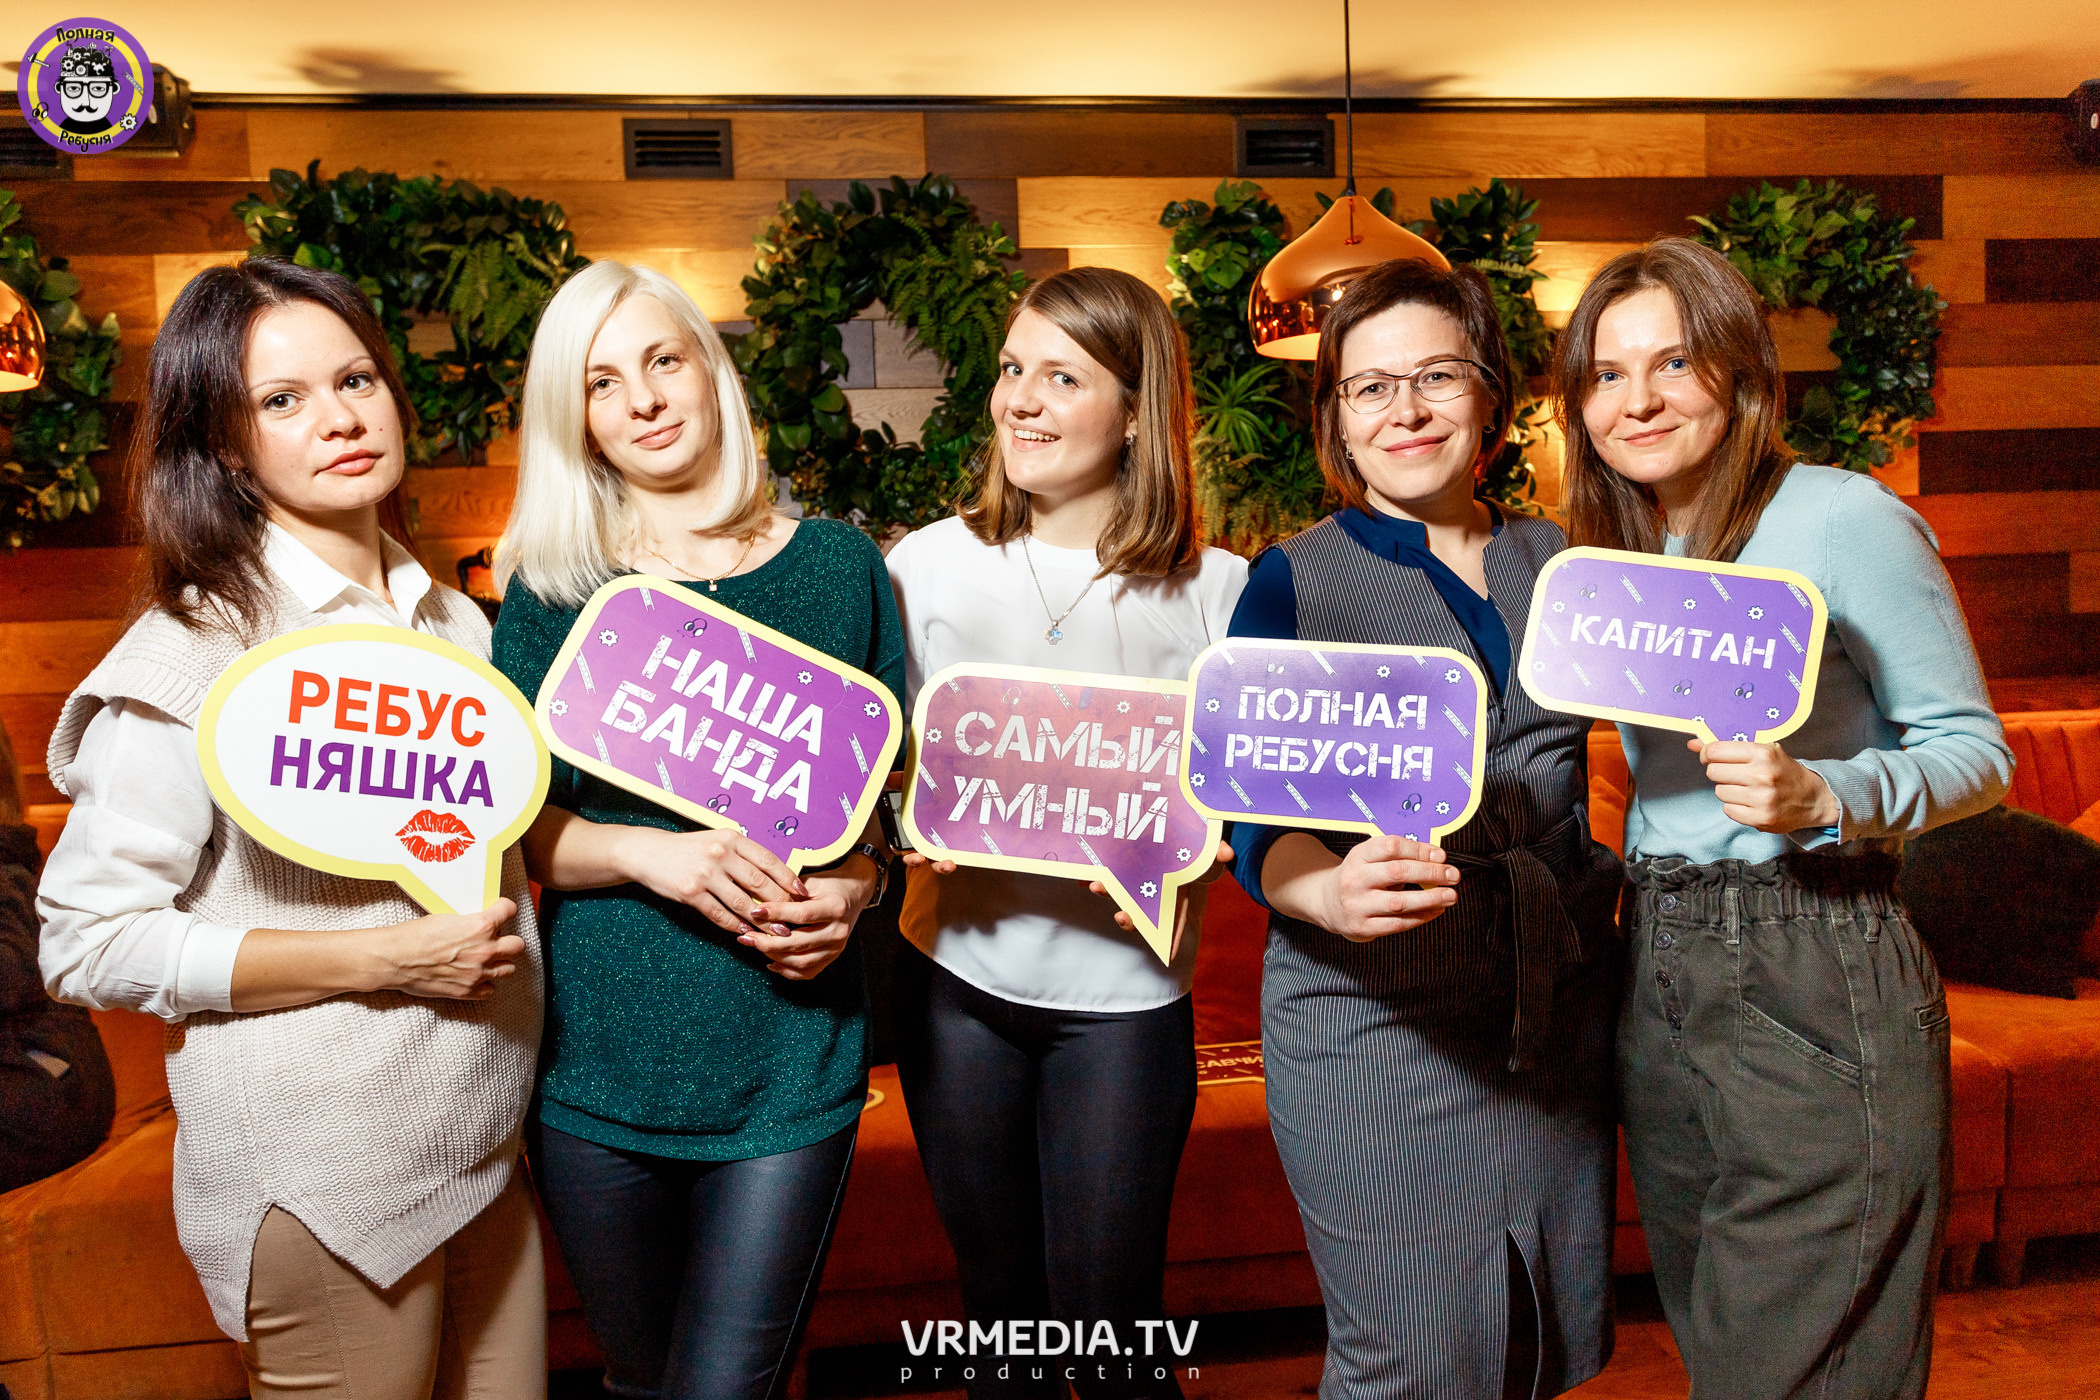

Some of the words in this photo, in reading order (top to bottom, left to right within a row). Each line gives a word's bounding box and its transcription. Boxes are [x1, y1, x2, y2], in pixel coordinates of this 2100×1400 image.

[1570, 613, 1776, 669] КАПИТАН
[288, 670, 487, 747] РЕБУС
[641, 635, 824, 757] НАША
[1238, 685, 1428, 730] ПОЛНАЯ
[270, 735, 494, 808] НЯШКА
[600, 680, 812, 814] БАНДА
[954, 711, 1181, 776] САМЫЙ
[1224, 733, 1434, 782] РЕБУСНЯ
[947, 775, 1169, 843] УМНЫЙ
